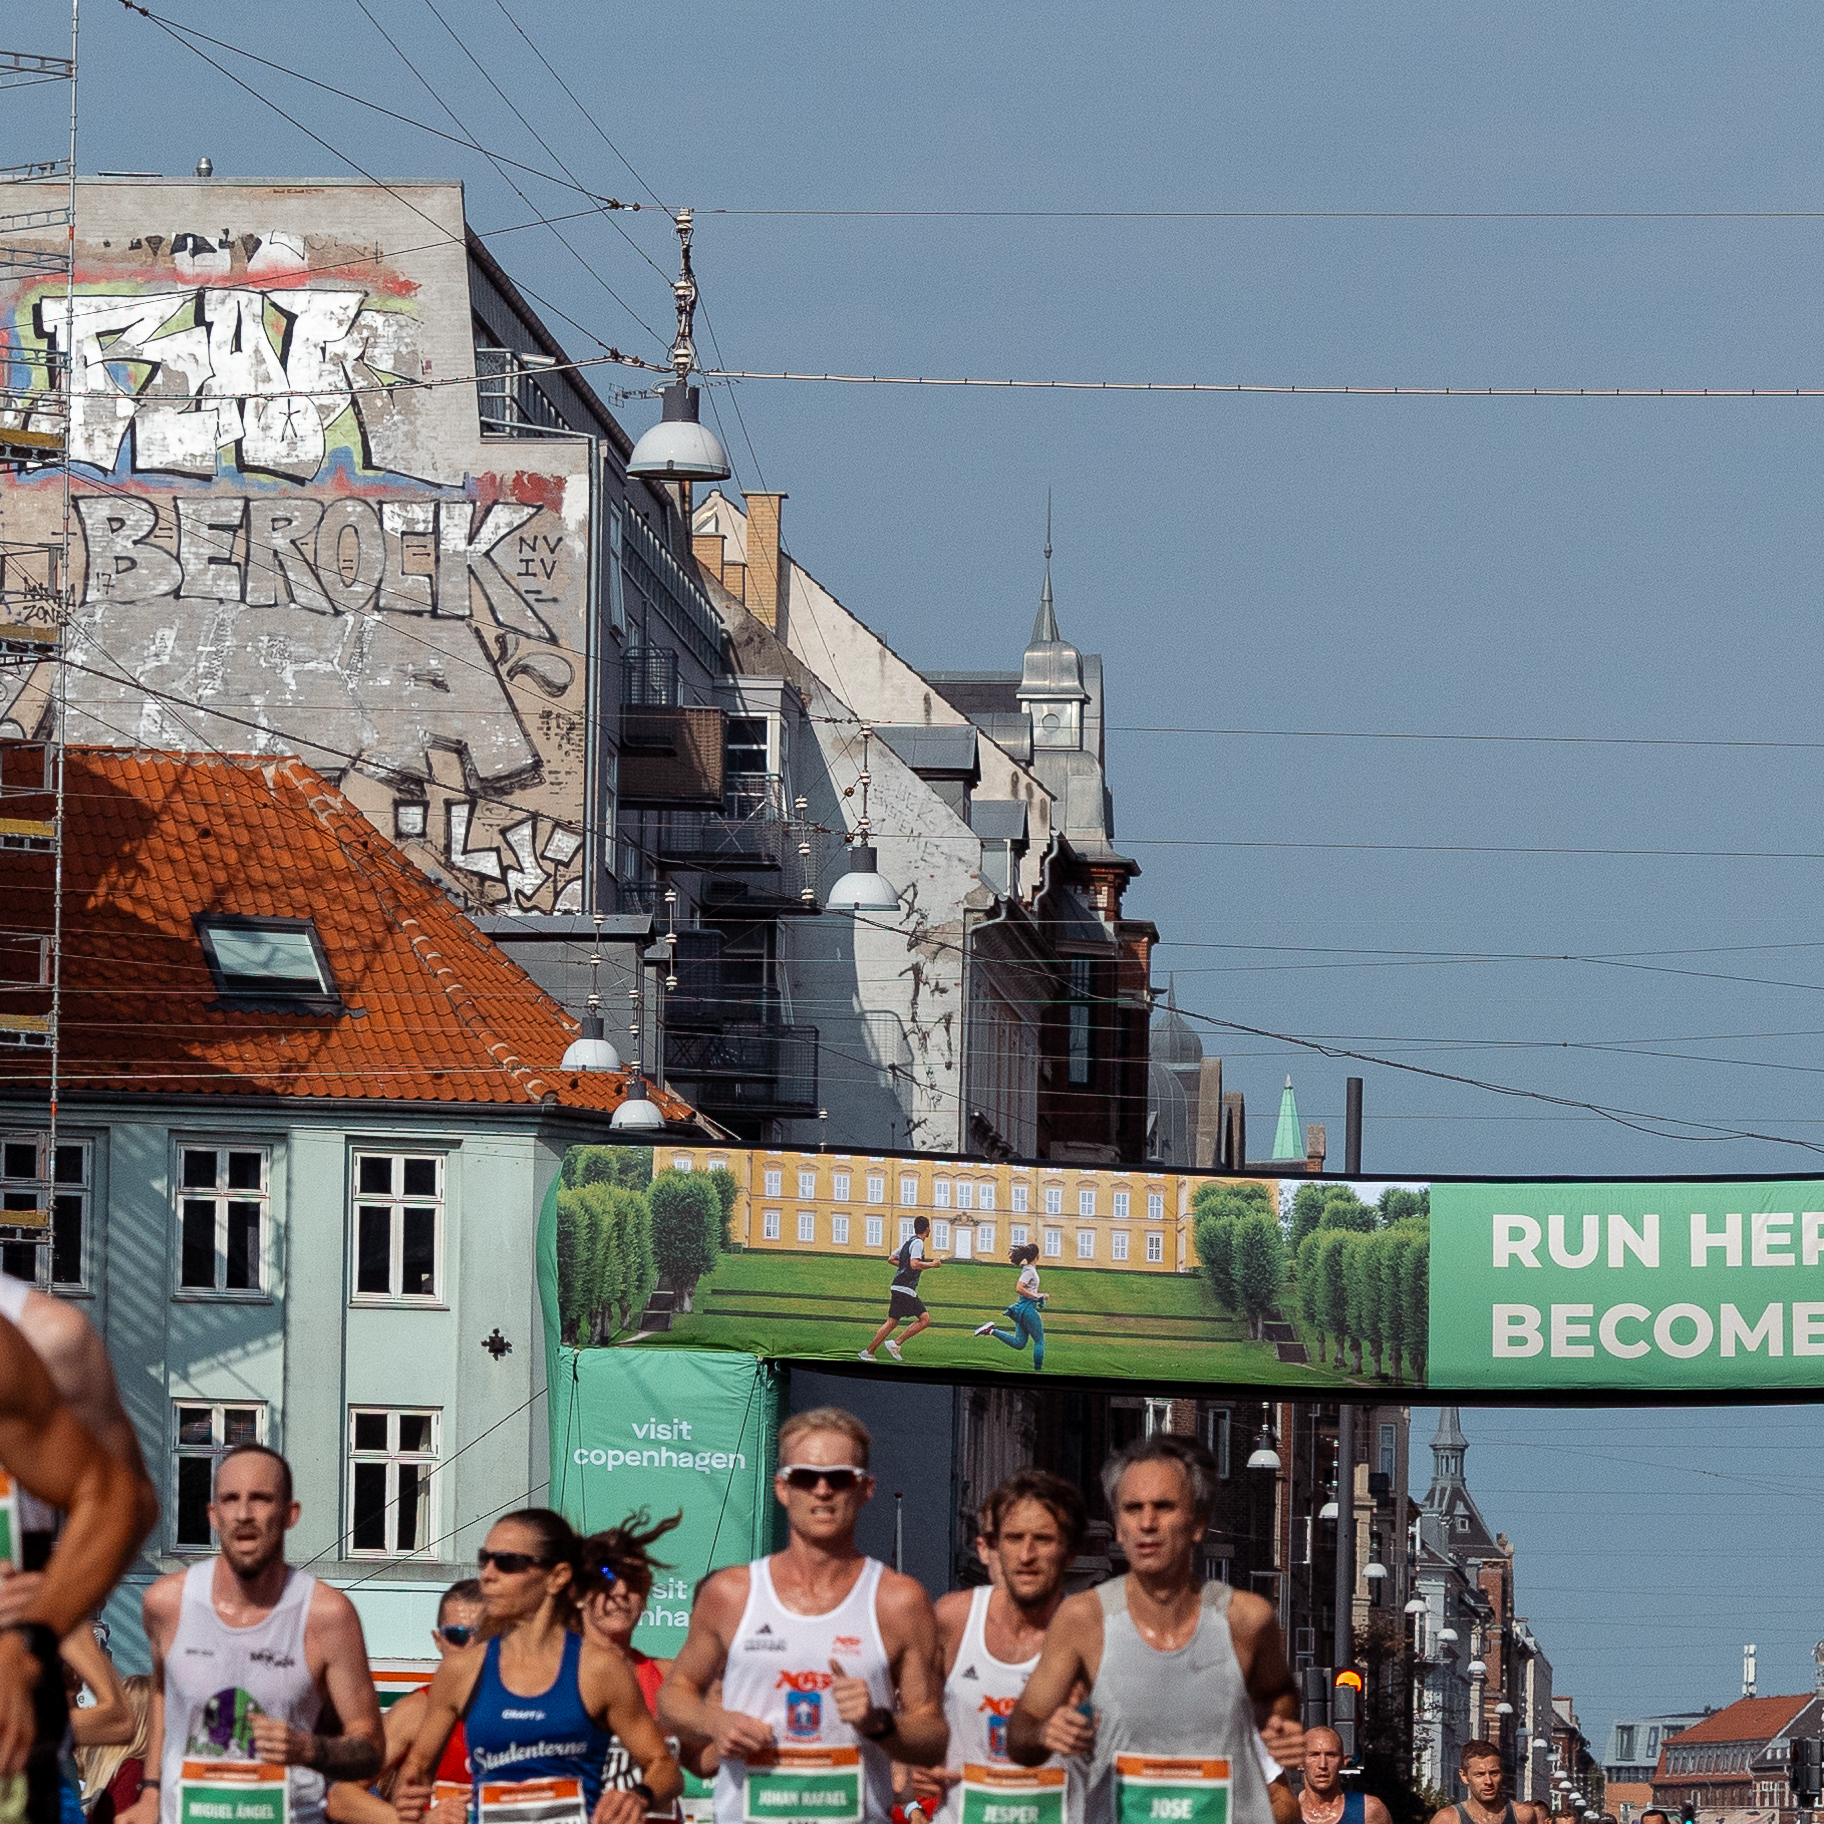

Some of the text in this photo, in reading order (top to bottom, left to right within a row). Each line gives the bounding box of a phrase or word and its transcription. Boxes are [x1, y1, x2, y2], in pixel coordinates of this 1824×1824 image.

[1492, 1213, 1660, 1269] RUN
[631, 1417, 692, 1441] visit
[573, 1446, 746, 1475] copenhagen
[651, 1577, 688, 1600] sit
[188, 1801, 234, 1820] MIGUEL
[982, 1804, 1039, 1824] JESPER
[1149, 1797, 1194, 1820] JOSE
